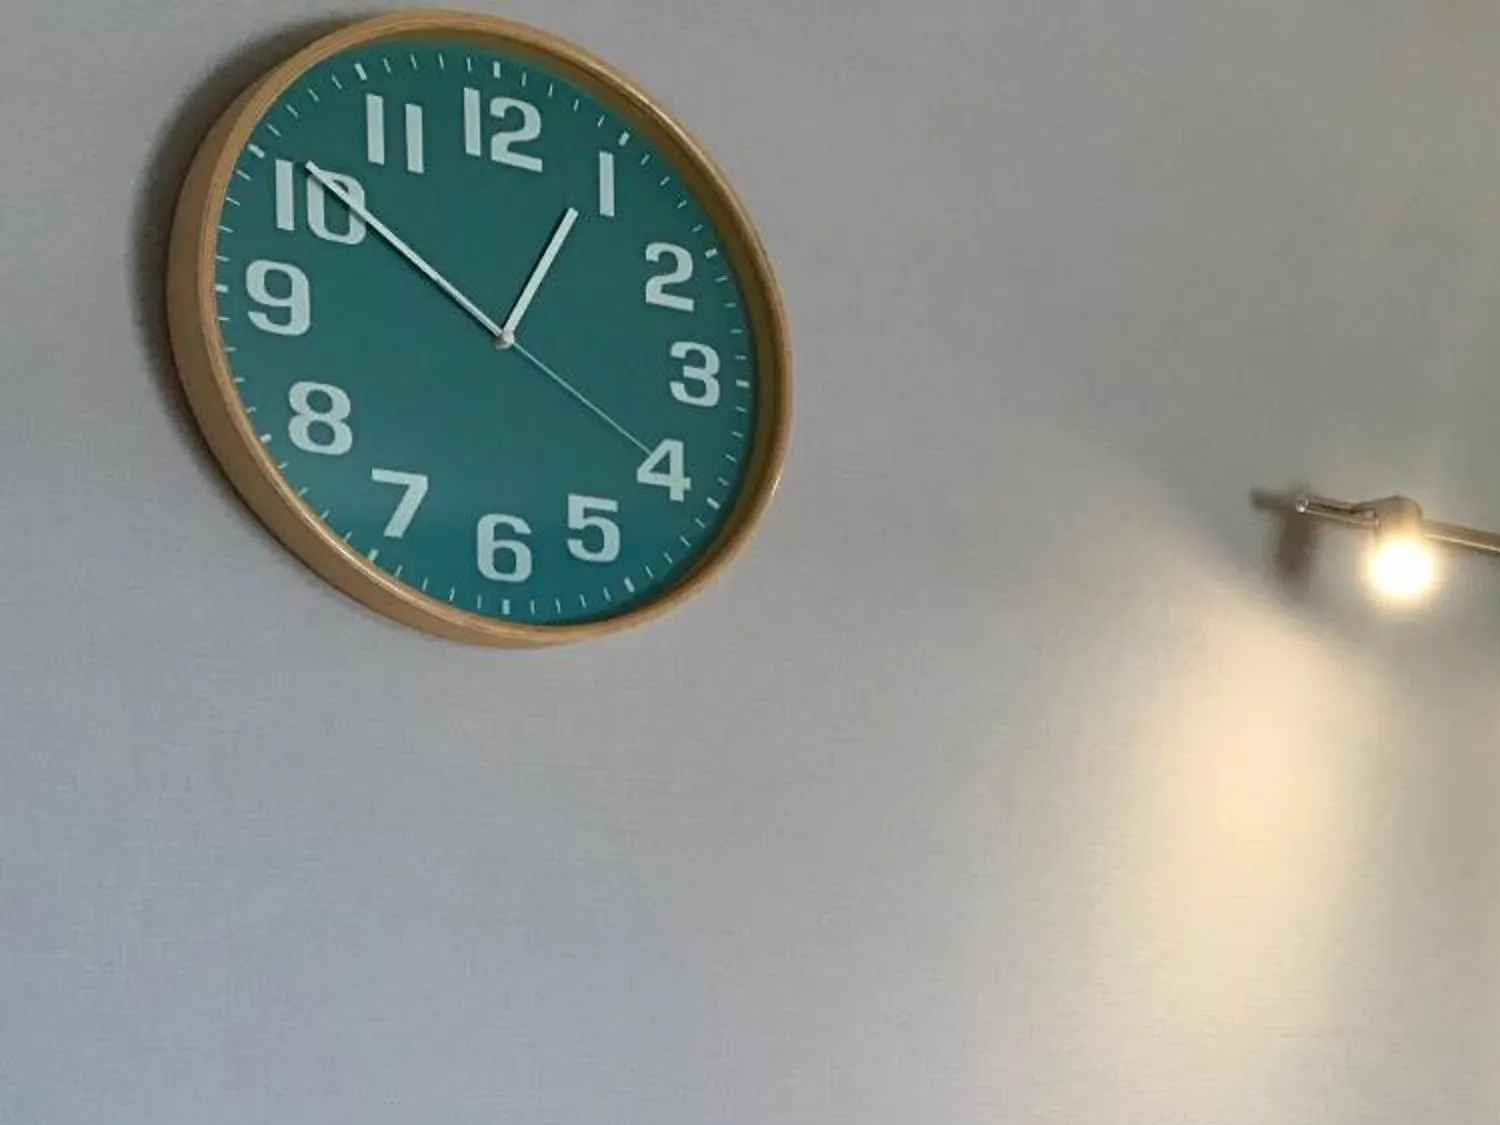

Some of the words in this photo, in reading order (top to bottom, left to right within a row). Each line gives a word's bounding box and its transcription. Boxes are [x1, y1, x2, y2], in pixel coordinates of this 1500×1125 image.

[366, 93, 424, 174] 11
[463, 87, 543, 172] 12
[275, 160, 366, 245] 10
[599, 152, 615, 216] 1
[245, 260, 310, 336] 9
[645, 241, 694, 312] 2
[670, 341, 721, 407] 3
[287, 381, 352, 455] 8
[371, 468, 428, 538] 7
[636, 438, 691, 502] 4
[476, 513, 533, 583] 6
[567, 493, 621, 563] 5
